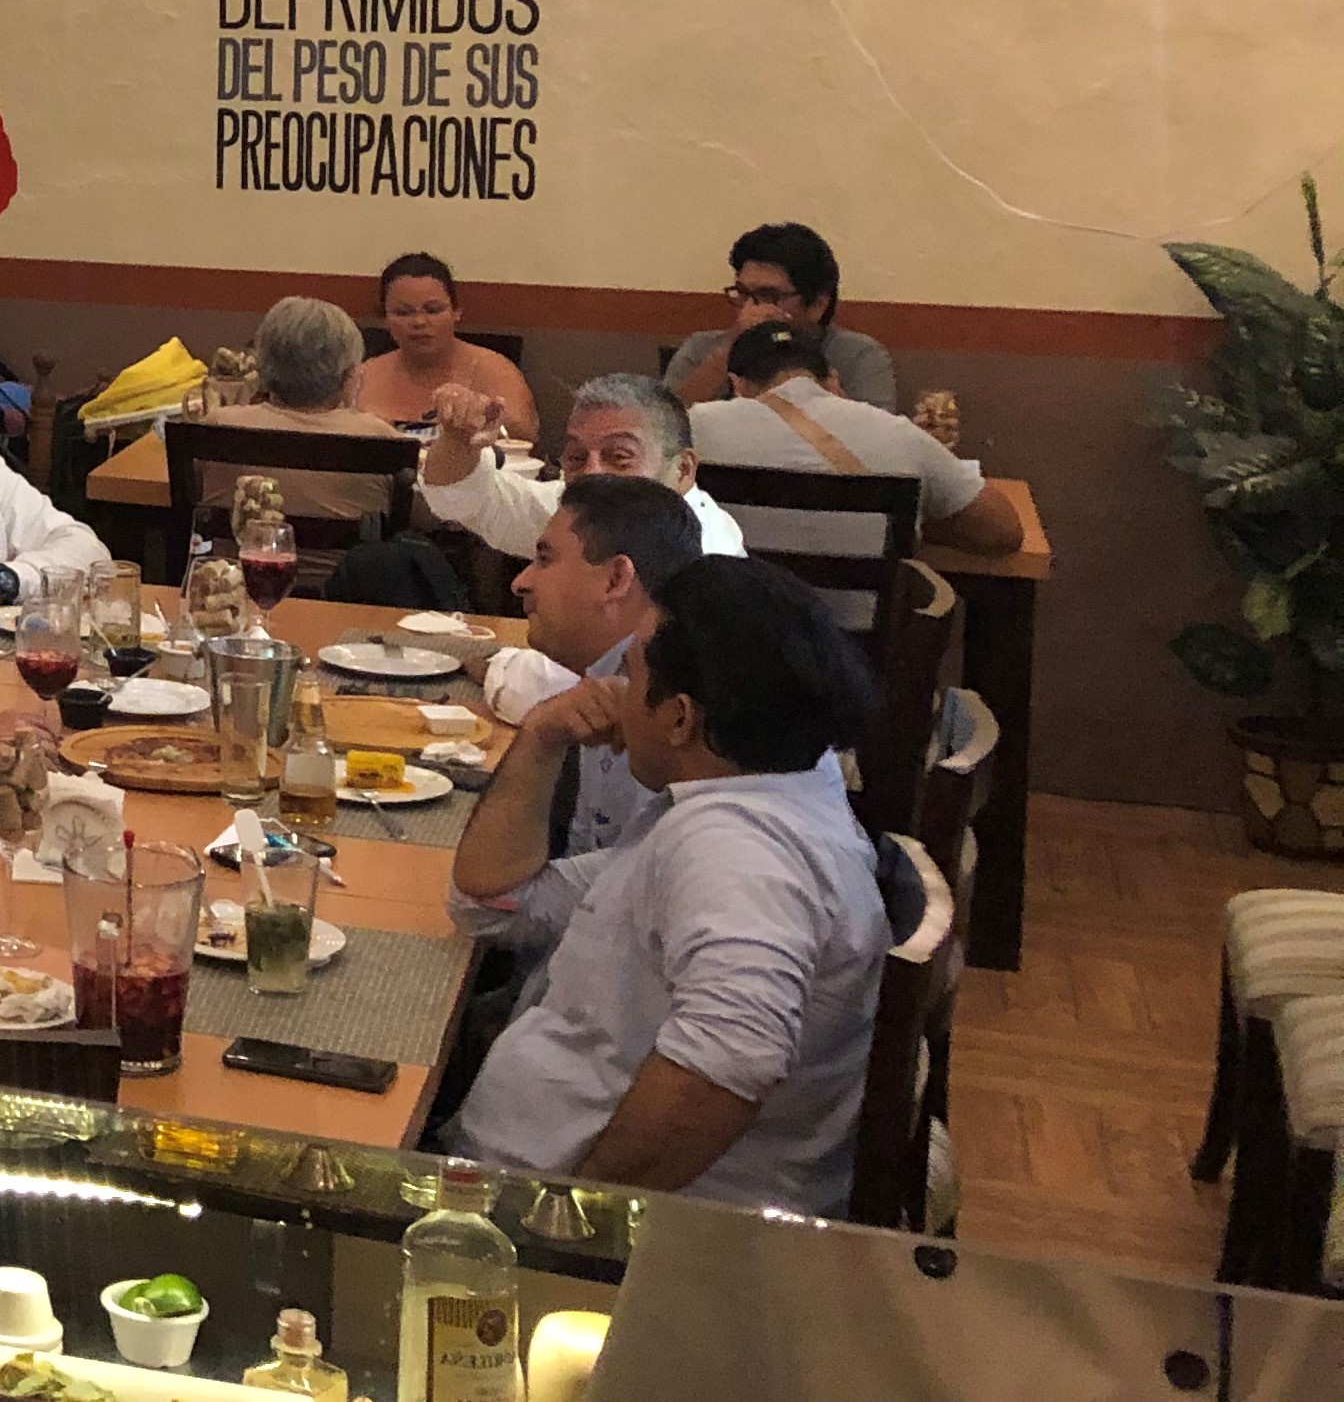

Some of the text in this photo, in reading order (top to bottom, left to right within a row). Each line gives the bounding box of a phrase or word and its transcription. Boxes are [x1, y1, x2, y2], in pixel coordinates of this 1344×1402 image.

[217, 37, 539, 110] DEL PESO DE SUS
[216, 108, 537, 201] PREOCUPACIONES
